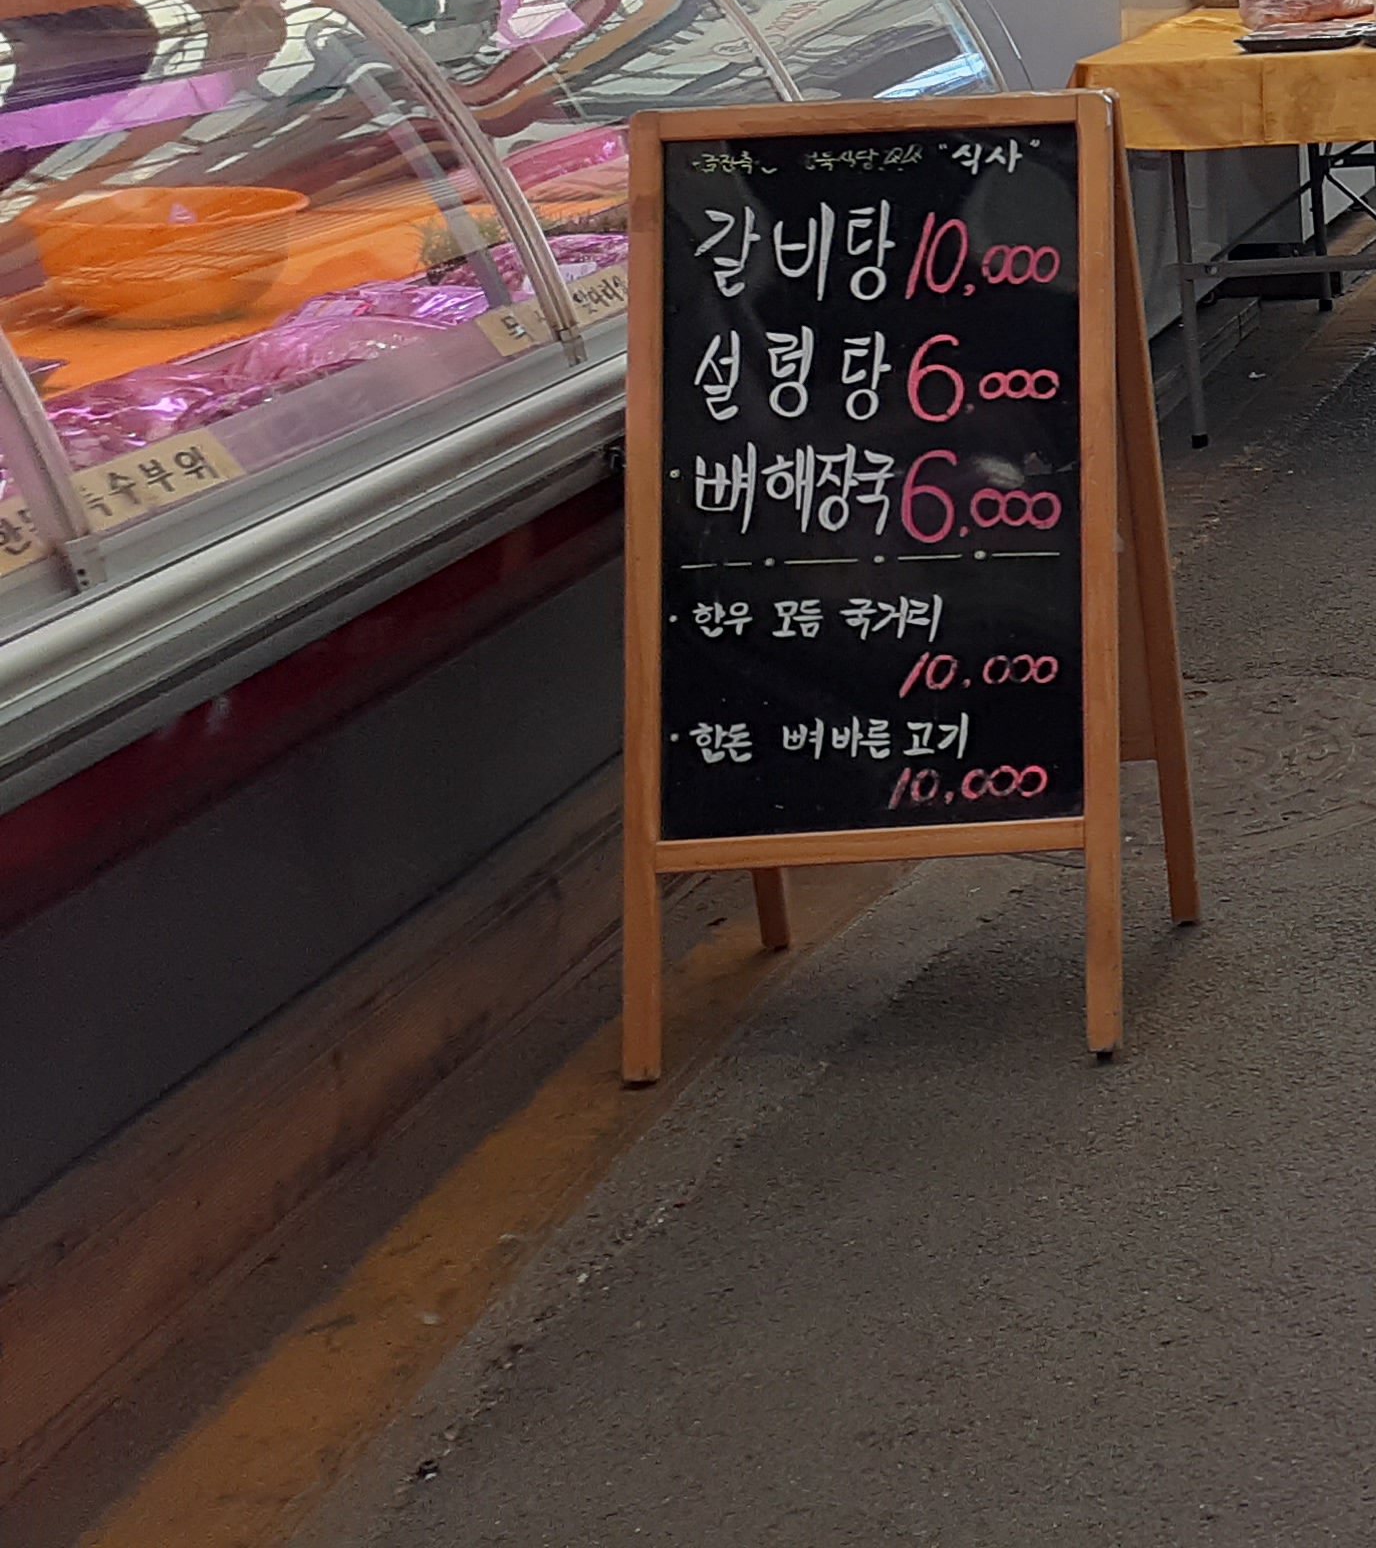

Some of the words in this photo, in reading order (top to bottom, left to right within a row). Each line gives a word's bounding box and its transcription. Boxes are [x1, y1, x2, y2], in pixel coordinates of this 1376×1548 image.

[693, 200, 898, 302] 갈비탕
[693, 327, 893, 422] 설렁탕
[694, 442, 898, 536] 뼈해장국
[692, 601, 751, 638] 한우
[770, 598, 824, 638] 모듬
[839, 594, 943, 641] 국거리
[690, 721, 754, 764] 한돈
[903, 712, 970, 759] 고기
